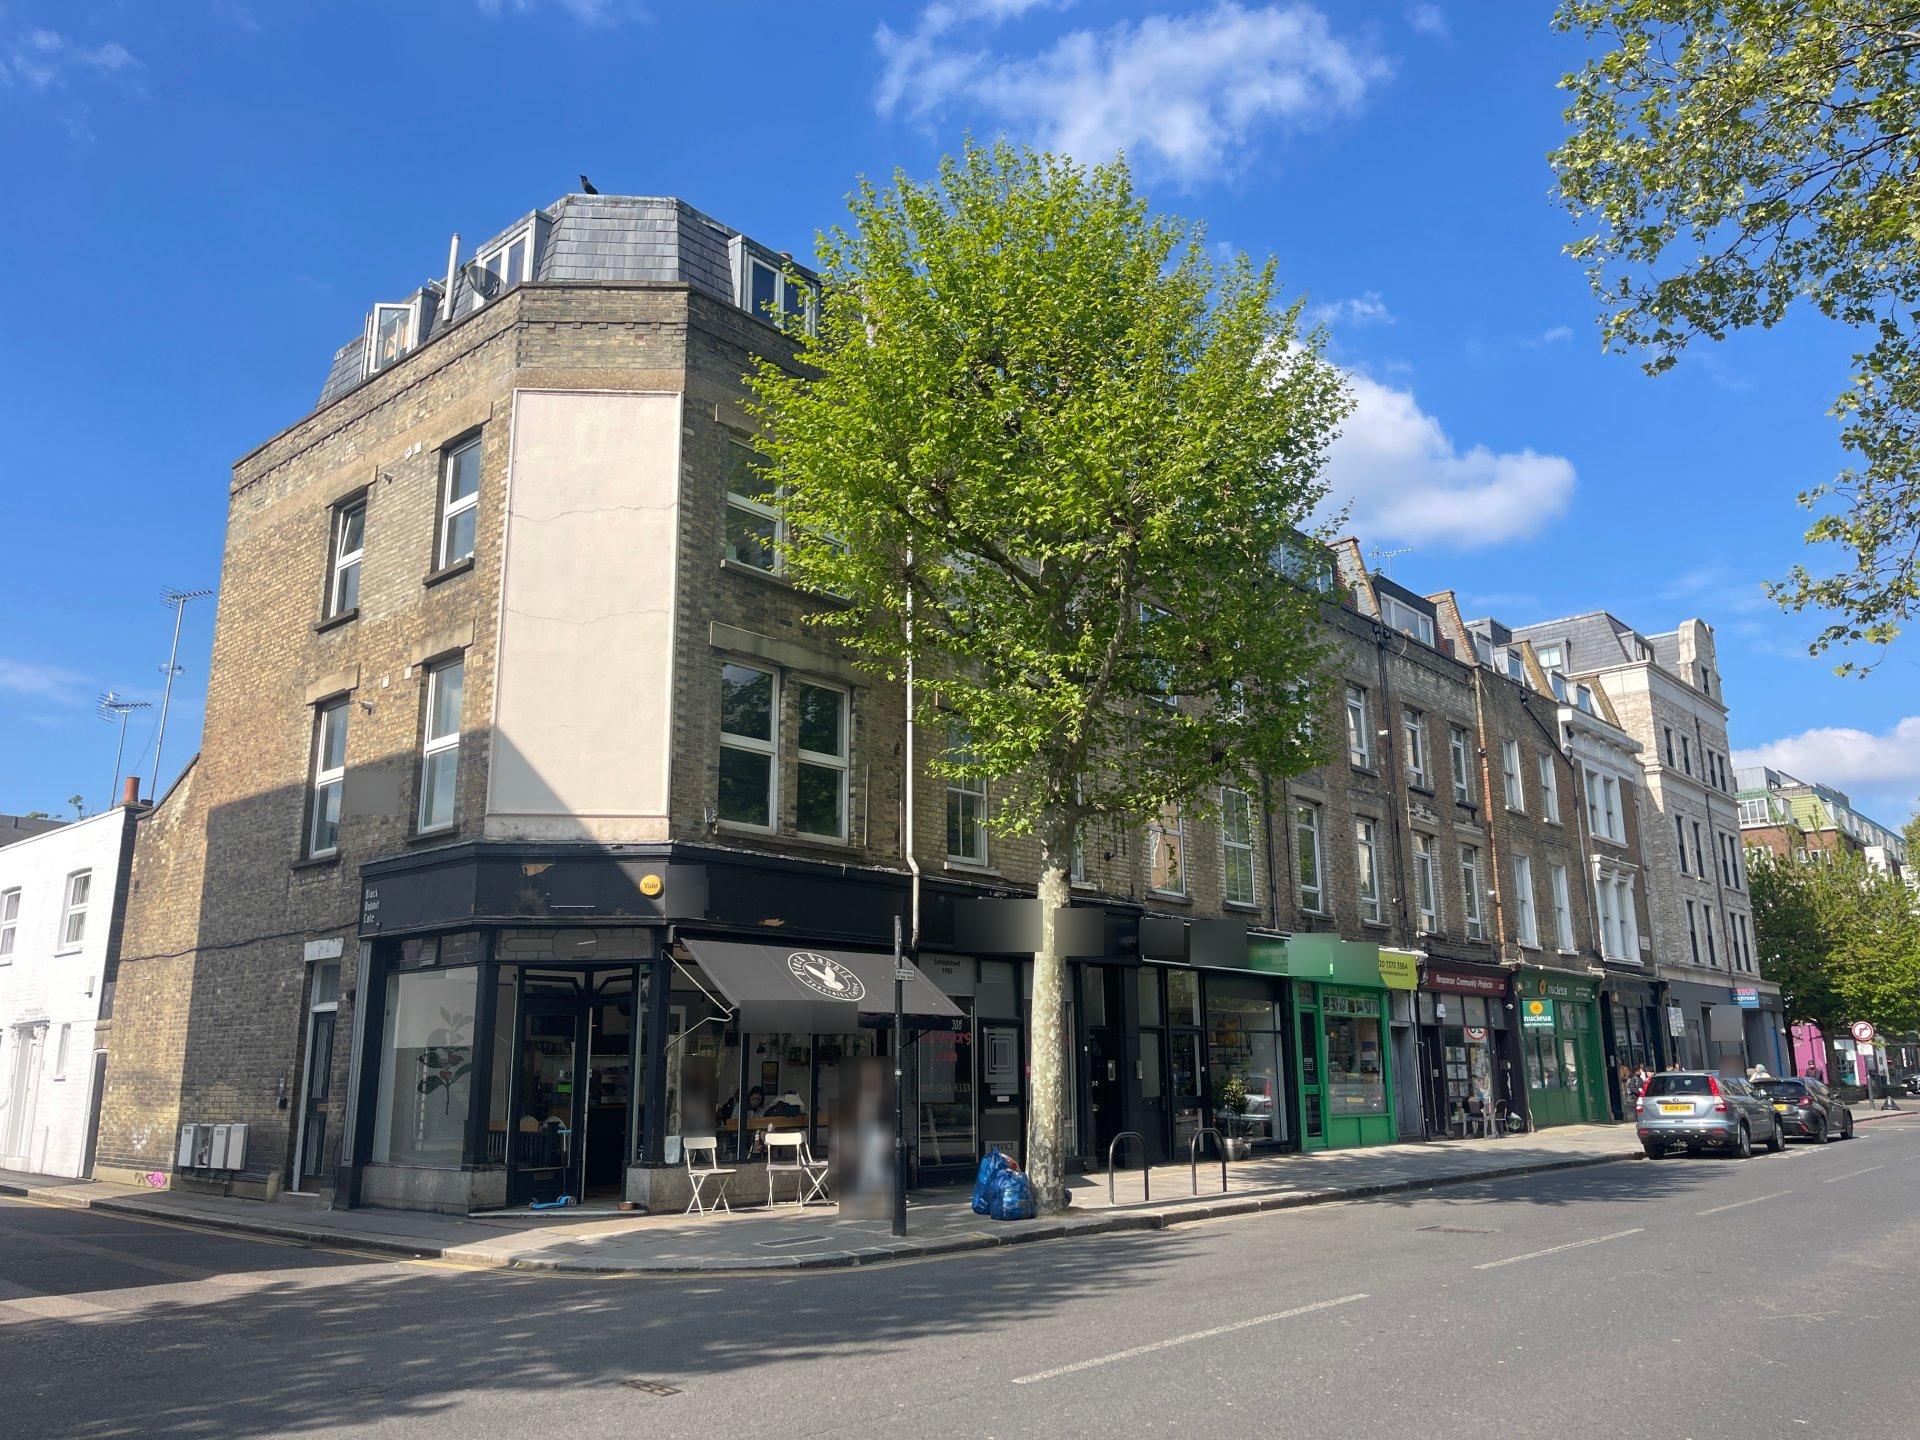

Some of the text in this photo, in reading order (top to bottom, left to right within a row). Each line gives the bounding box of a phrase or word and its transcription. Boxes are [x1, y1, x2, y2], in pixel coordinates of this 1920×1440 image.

[644, 881, 658, 889] Yale
[365, 889, 378, 899] Black
[792, 953, 852, 979] Black Rabbit
[1435, 974, 1494, 990] Response Community Projects
[1547, 983, 1568, 996] nucleus
[1523, 1014, 1552, 1022] nucleus
